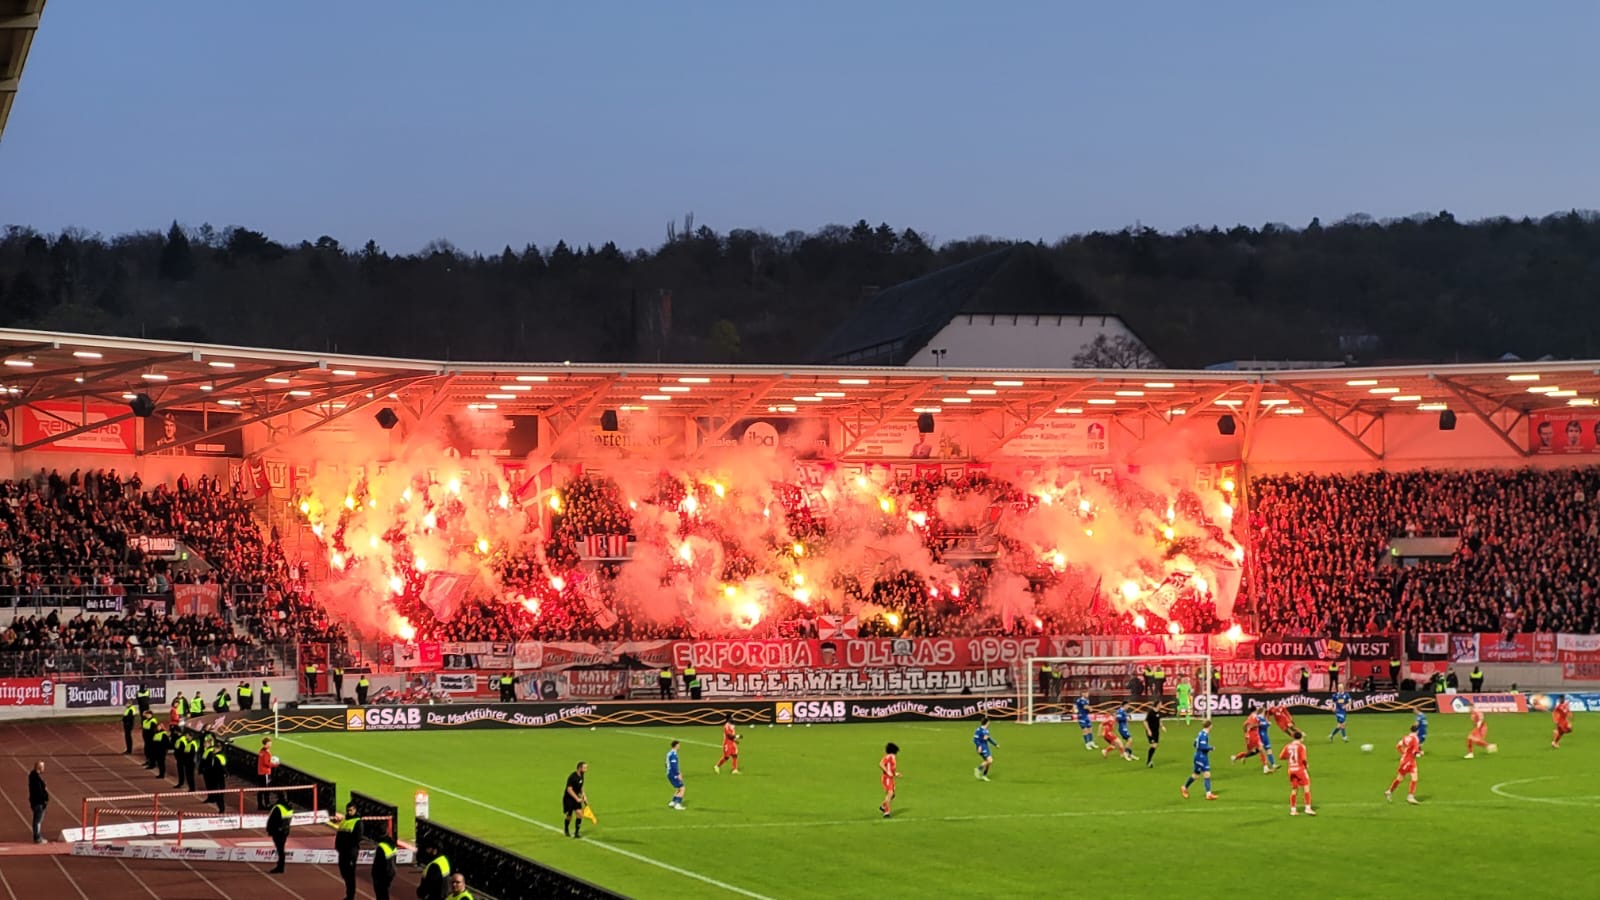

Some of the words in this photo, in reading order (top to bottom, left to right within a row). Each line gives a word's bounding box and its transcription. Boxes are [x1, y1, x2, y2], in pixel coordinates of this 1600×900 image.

[748, 431, 774, 447] iba
[672, 640, 813, 669] ERFORDIA
[846, 639, 956, 668] ULTRAS
[1261, 642, 1314, 656] GOTHA
[1346, 641, 1391, 656] WEST
[0, 682, 40, 705] ingen
[67, 685, 109, 704] Brigade
[794, 701, 845, 718] GSAB
[852, 705, 869, 716] Der
[871, 701, 928, 717] Marktführer
[963, 705, 975, 716] im
[1194, 694, 1243, 711] GSAB
[1353, 699, 1364, 710] im
[366, 708, 421, 725] GSAB
[427, 711, 445, 723] Der
[447, 708, 507, 723] Marktführer
[545, 712, 558, 722] im
